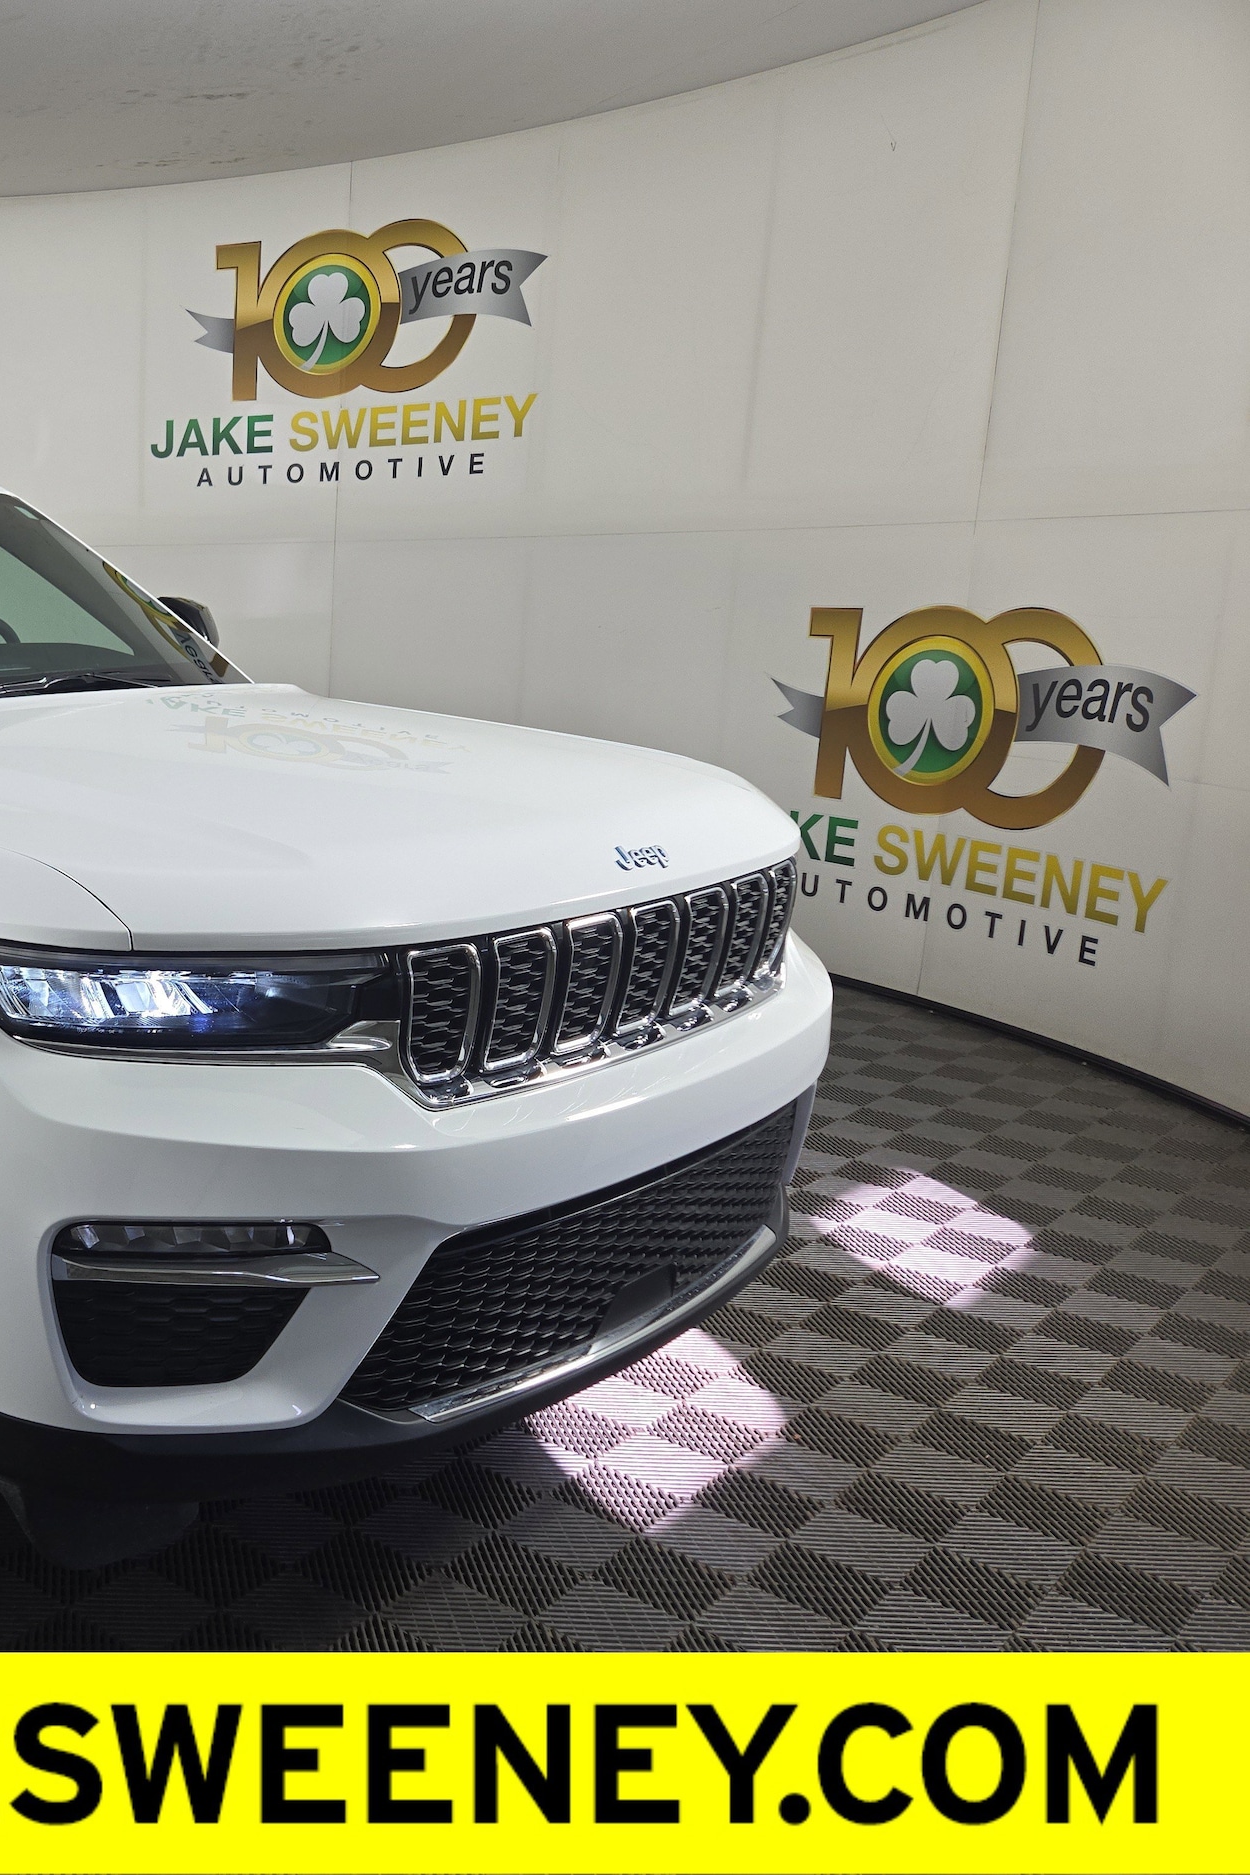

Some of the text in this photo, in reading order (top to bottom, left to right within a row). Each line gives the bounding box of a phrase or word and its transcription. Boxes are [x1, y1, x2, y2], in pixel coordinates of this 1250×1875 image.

[215, 218, 514, 401] 100 years
[151, 392, 539, 459] JAKE SWEENEY
[196, 452, 486, 488] AUTOMOTIVE
[808, 605, 1155, 830] 100 years
[613, 844, 670, 872] Jeep
[790, 810, 1170, 934] KE SWEENEY
[800, 872, 1100, 967] UTOMOTIVE
